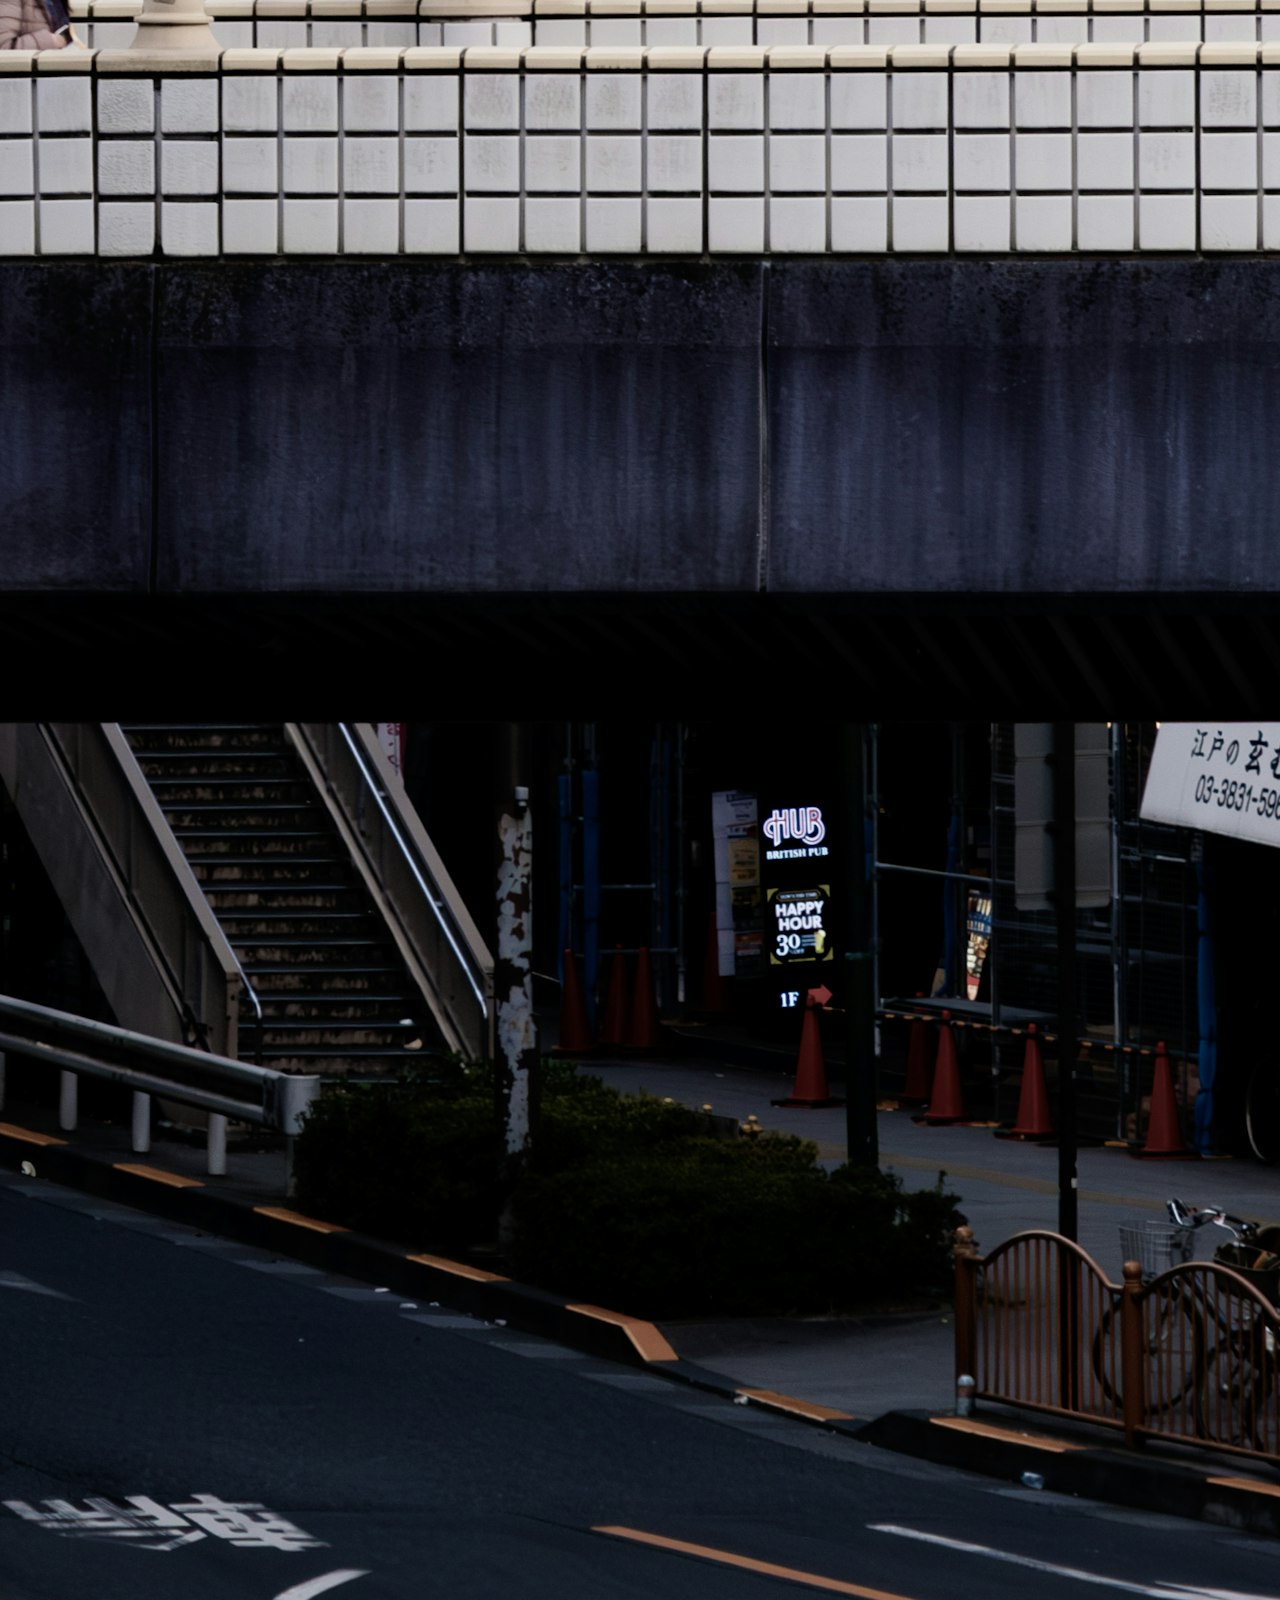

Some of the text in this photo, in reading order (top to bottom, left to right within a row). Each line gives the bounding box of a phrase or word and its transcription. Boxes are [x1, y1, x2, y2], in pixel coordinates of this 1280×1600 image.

[763, 806, 826, 847] HUB
[766, 846, 829, 860] BRITISH PUB
[775, 900, 825, 917] HAPPY
[778, 915, 823, 931] HOUR
[776, 933, 801, 956] 30
[780, 991, 800, 1008] 1F
